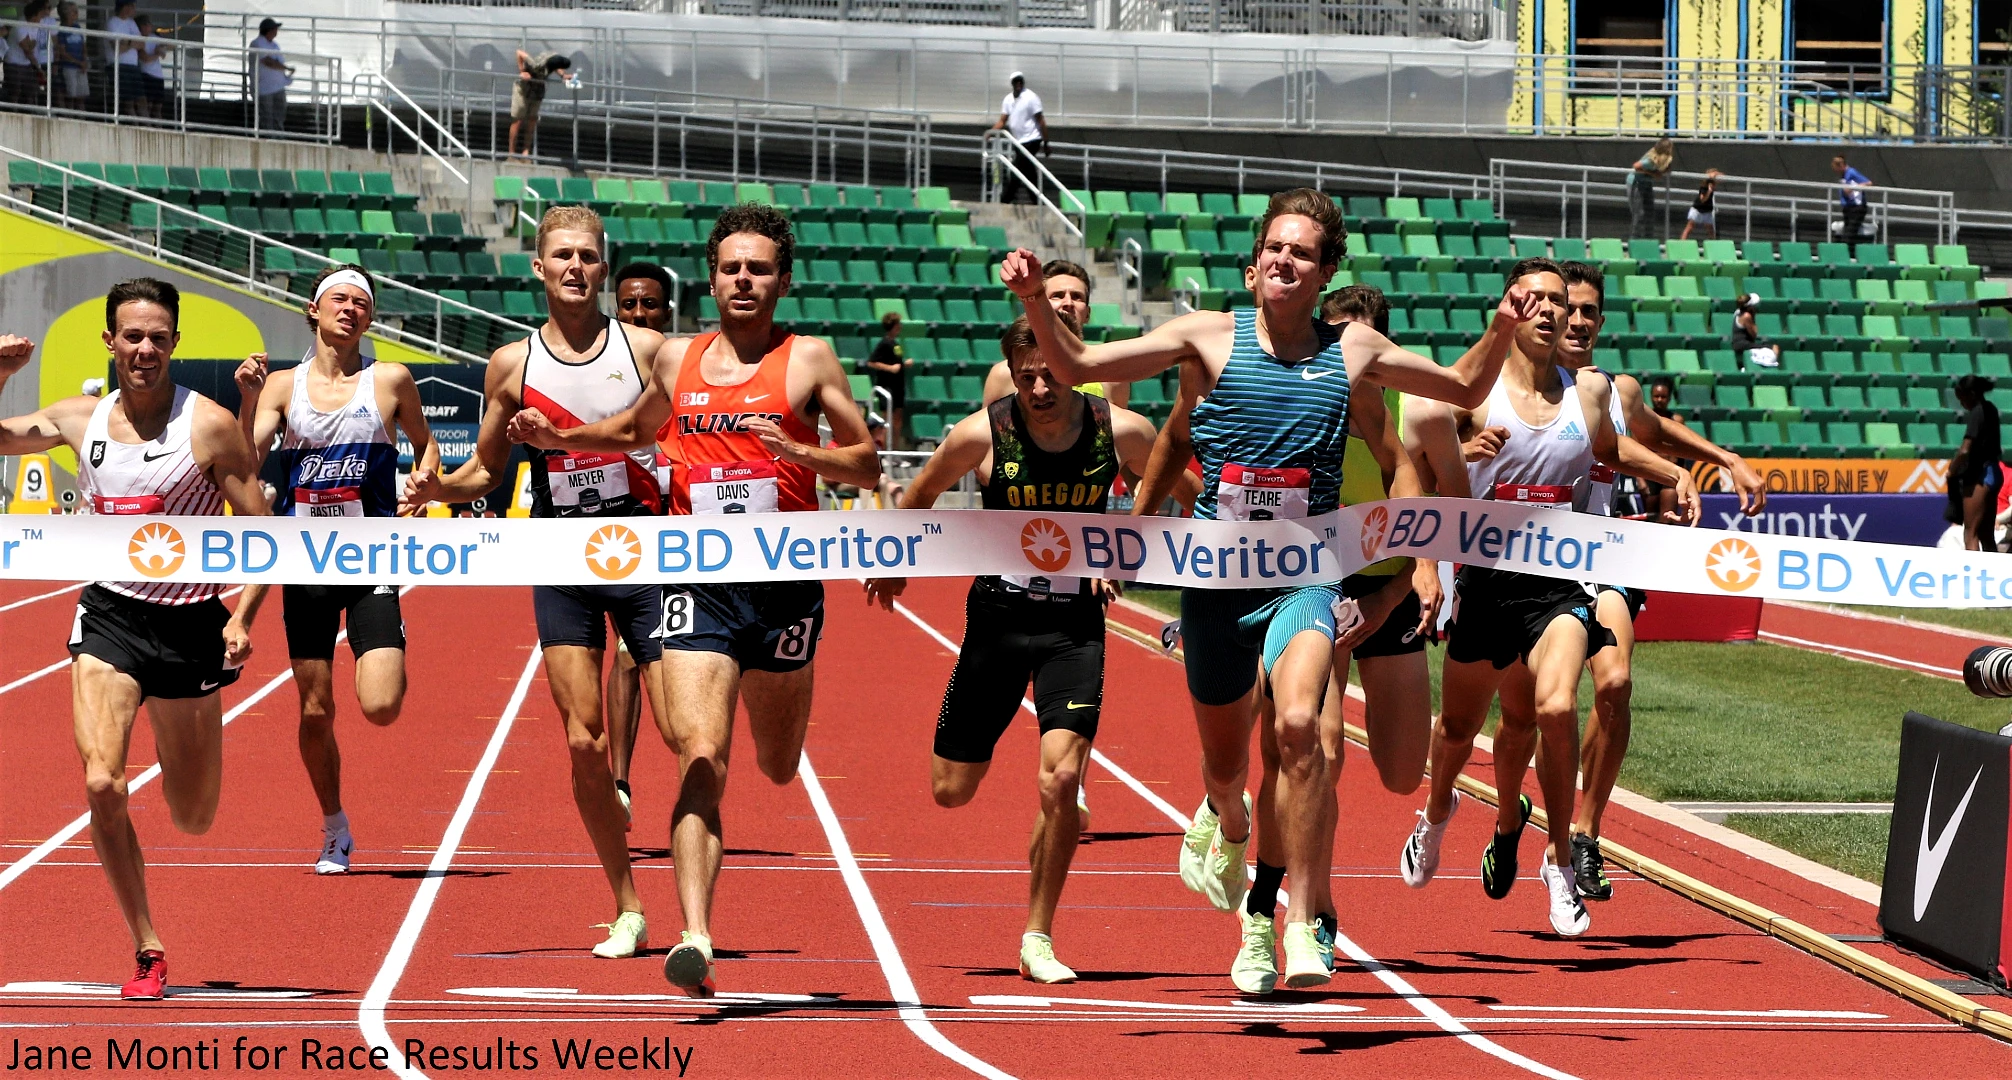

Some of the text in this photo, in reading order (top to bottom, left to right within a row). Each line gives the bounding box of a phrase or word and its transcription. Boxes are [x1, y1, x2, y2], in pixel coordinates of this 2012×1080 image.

[1557, 432, 1584, 441] adidas
[298, 454, 368, 485] Drake
[577, 456, 602, 465] TOYOTA
[724, 468, 752, 476] TOYOTA
[27, 469, 42, 492] 9
[567, 469, 605, 488] MEYER
[1257, 475, 1286, 483] TOYOTA
[1757, 469, 1888, 493] OURNEY
[716, 483, 750, 501] DAVIS
[1007, 483, 1104, 507] OREGON
[1244, 489, 1282, 507] TEARE
[310, 504, 346, 517] BASTEN
[1387, 509, 1442, 549] BD
[201, 529, 279, 574] BD
[657, 529, 733, 573] BD
[1082, 526, 1147, 571] BD
[1777, 549, 1853, 593] BD
[666, 596, 688, 632] 8
[780, 620, 807, 658] 8
